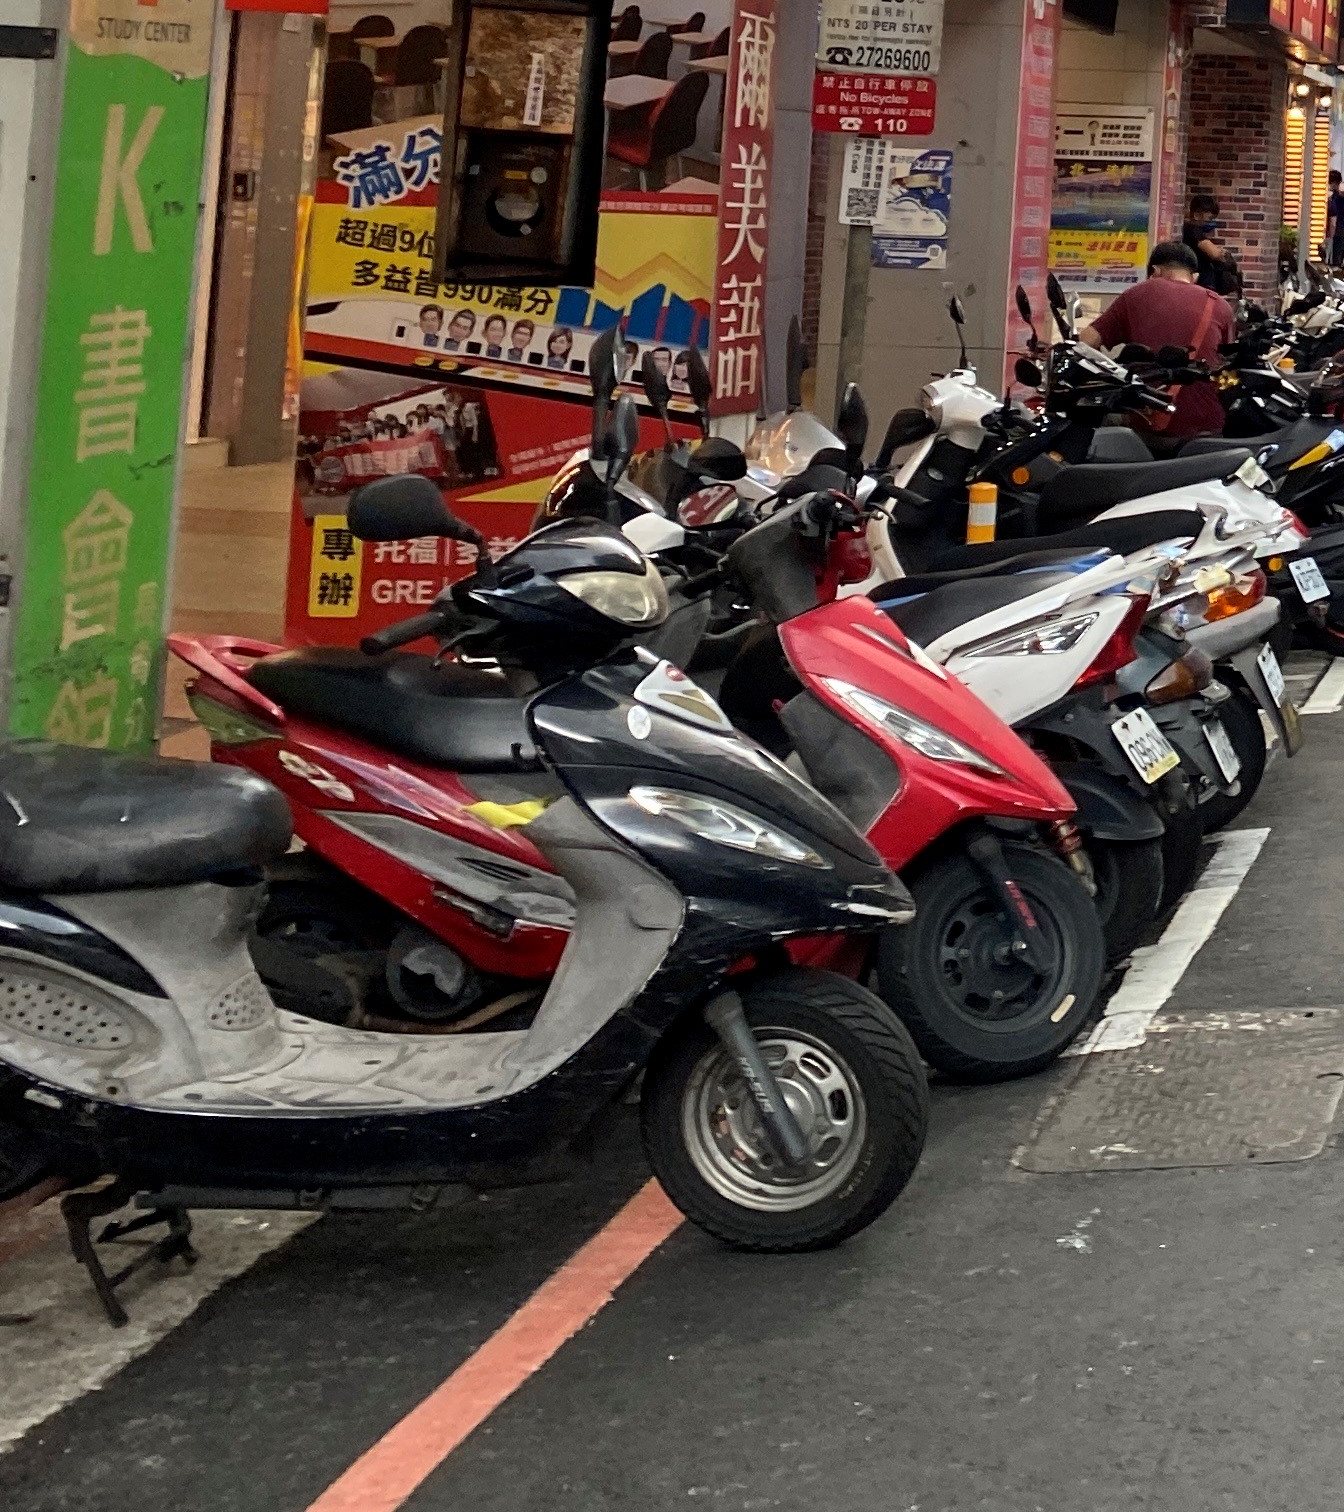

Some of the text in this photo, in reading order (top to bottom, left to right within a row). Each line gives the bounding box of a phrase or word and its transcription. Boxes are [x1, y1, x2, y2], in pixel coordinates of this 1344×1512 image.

[97, 17, 191, 43] STUDY CENTER
[855, 20, 933, 35] 20 PER STAY
[856, 46, 931, 72] 27269600
[840, 91, 909, 105] No Bicycles
[874, 119, 908, 132] 110
[371, 579, 434, 605] GRE
